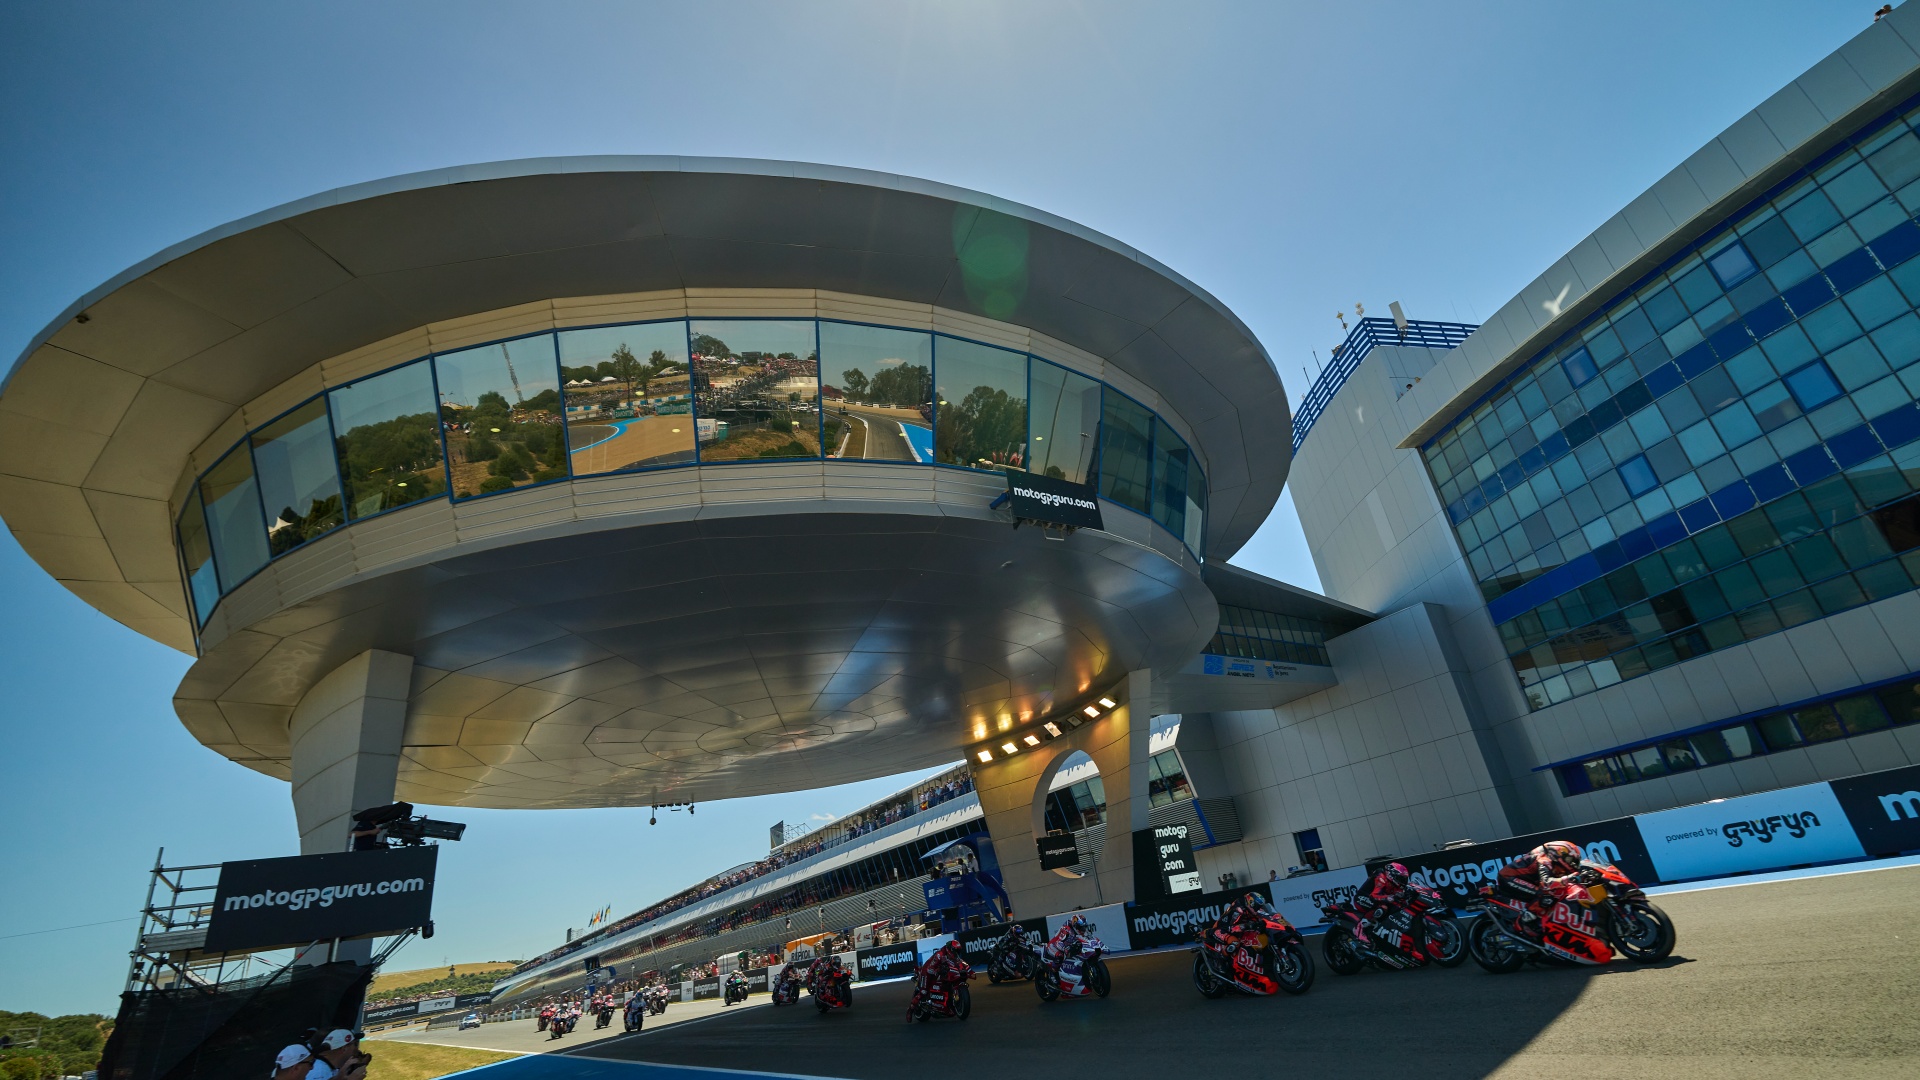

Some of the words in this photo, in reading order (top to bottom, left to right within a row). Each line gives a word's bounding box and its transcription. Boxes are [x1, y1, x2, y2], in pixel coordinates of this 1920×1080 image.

[1013, 486, 1097, 510] motogpguru.com
[1155, 825, 1188, 839] motogp
[1666, 830, 1704, 843] powered
[1706, 826, 1718, 838] by
[1160, 843, 1180, 858] guru
[1163, 859, 1185, 871] .com
[223, 877, 424, 911] motogpguru.com
[861, 950, 914, 972] motogpguru.com
